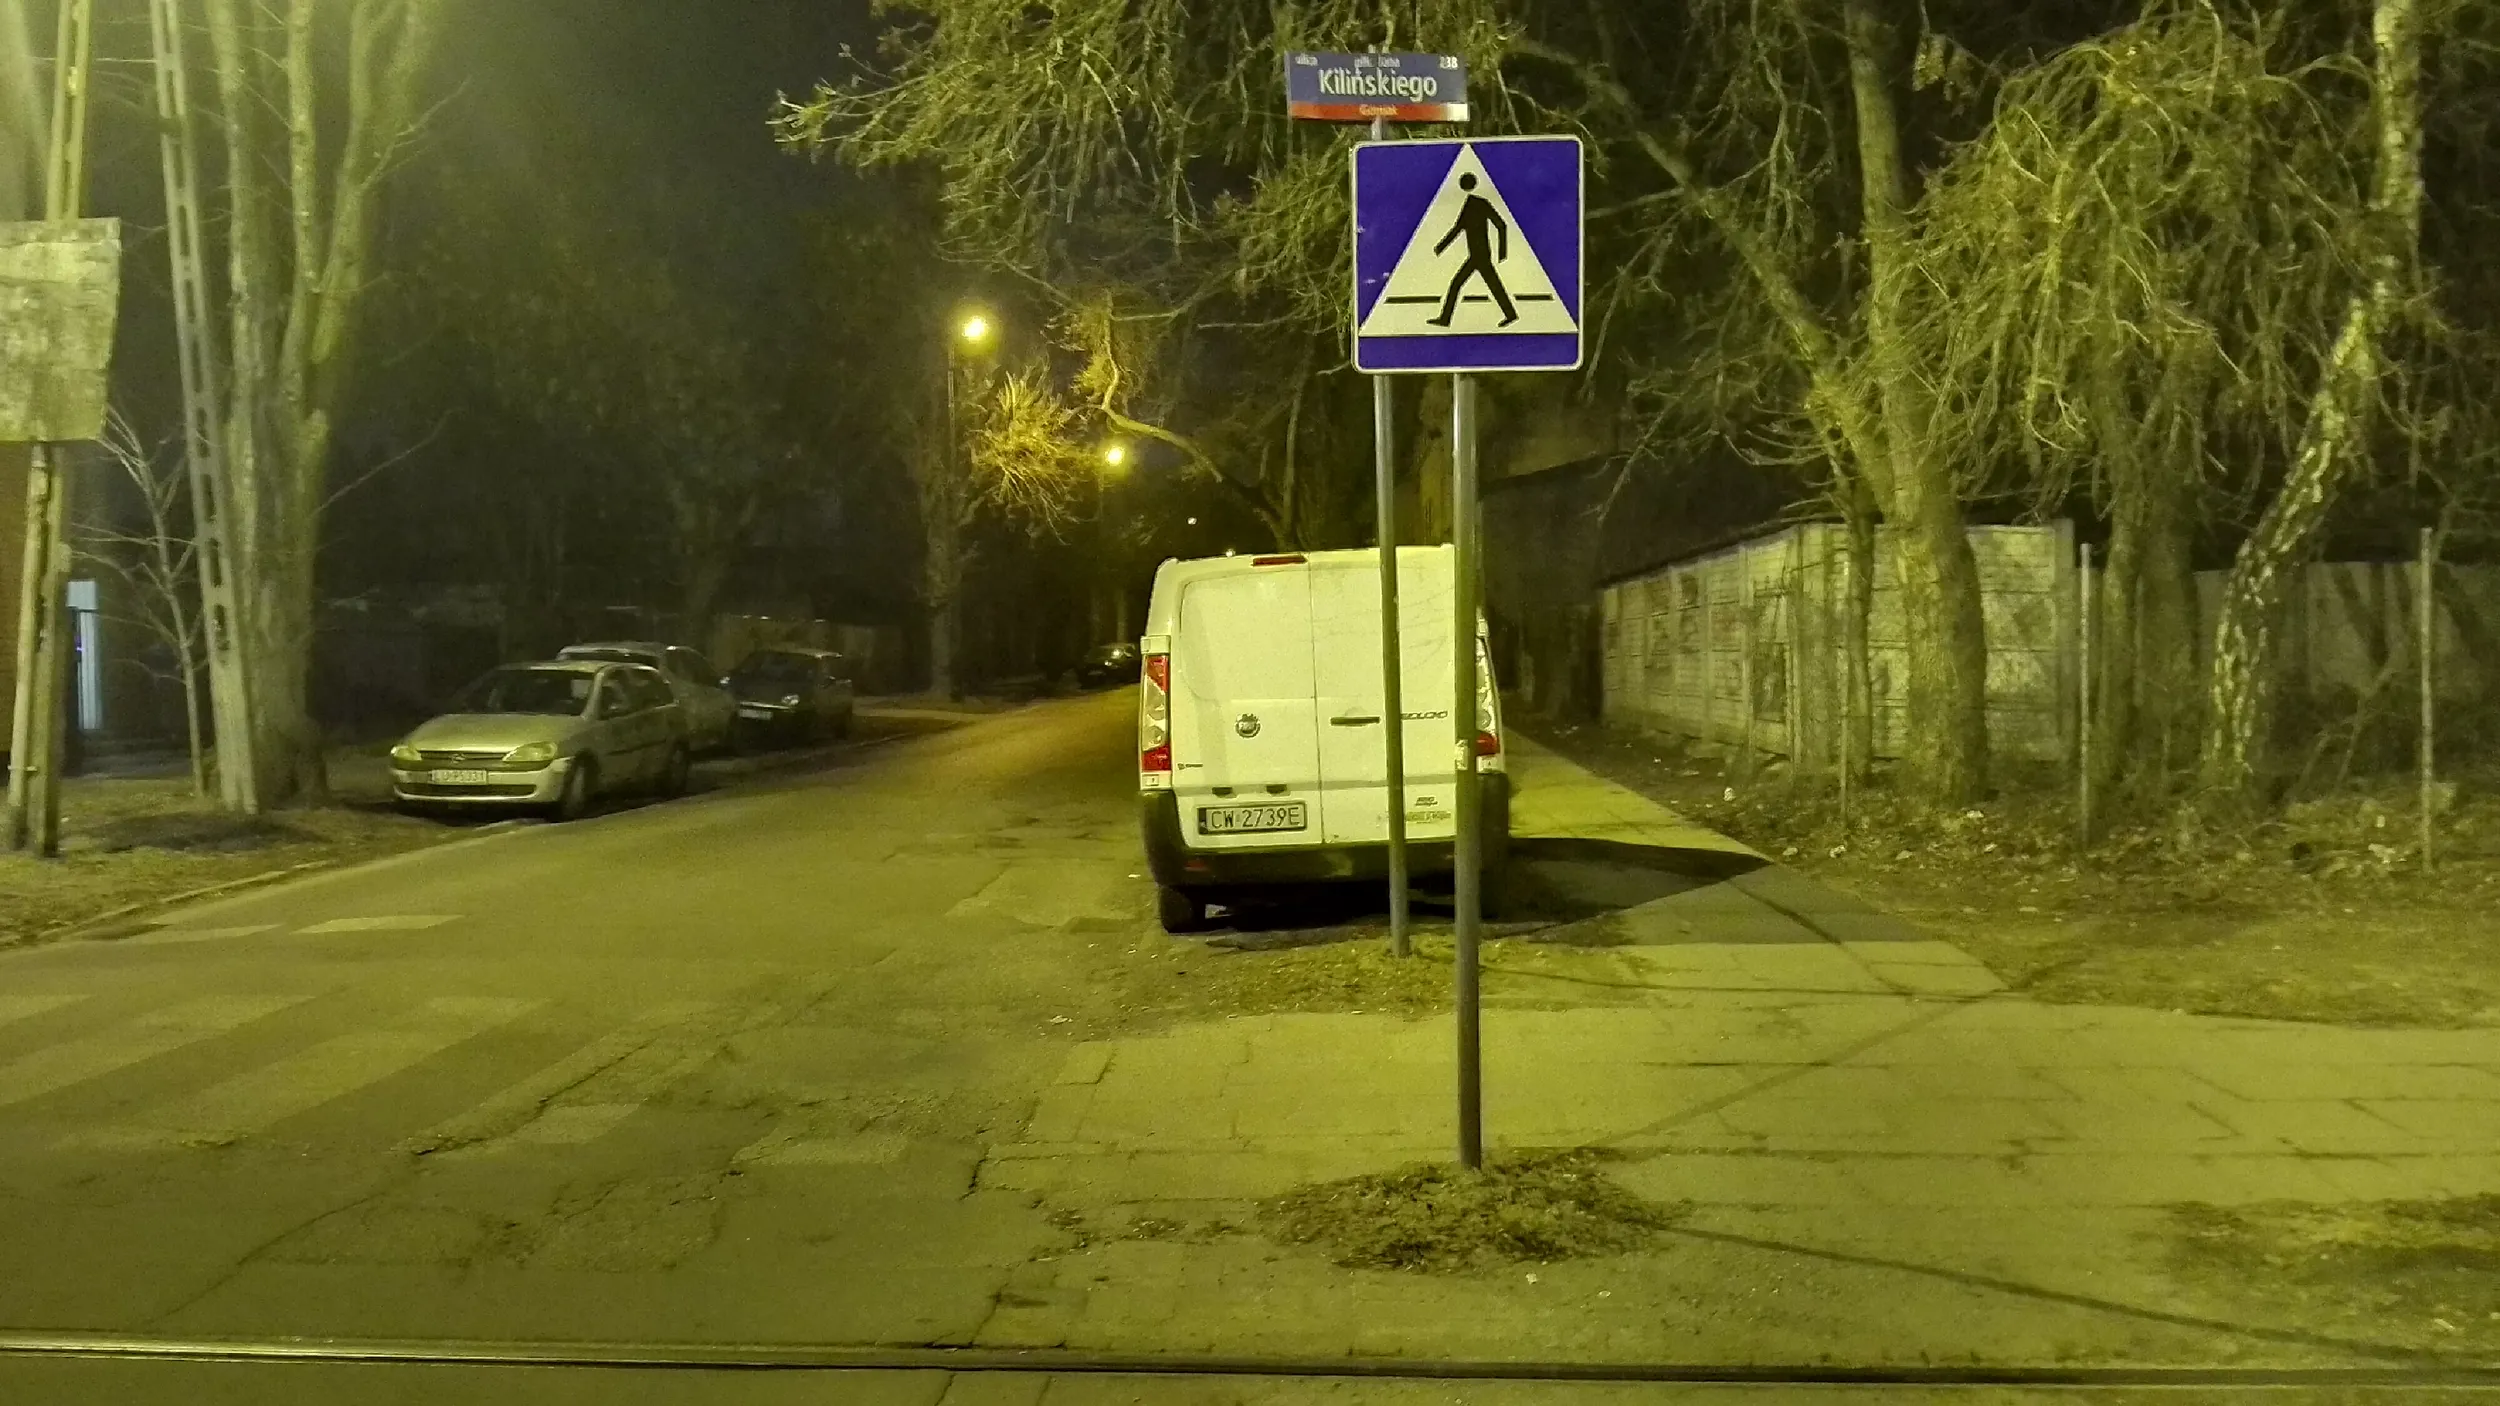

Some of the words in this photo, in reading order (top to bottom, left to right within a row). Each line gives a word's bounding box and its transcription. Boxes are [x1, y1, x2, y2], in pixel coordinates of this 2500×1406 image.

[1318, 67, 1438, 102] Kilińskiego
[1211, 810, 1234, 829] CW
[1241, 806, 1301, 828] 2739E
